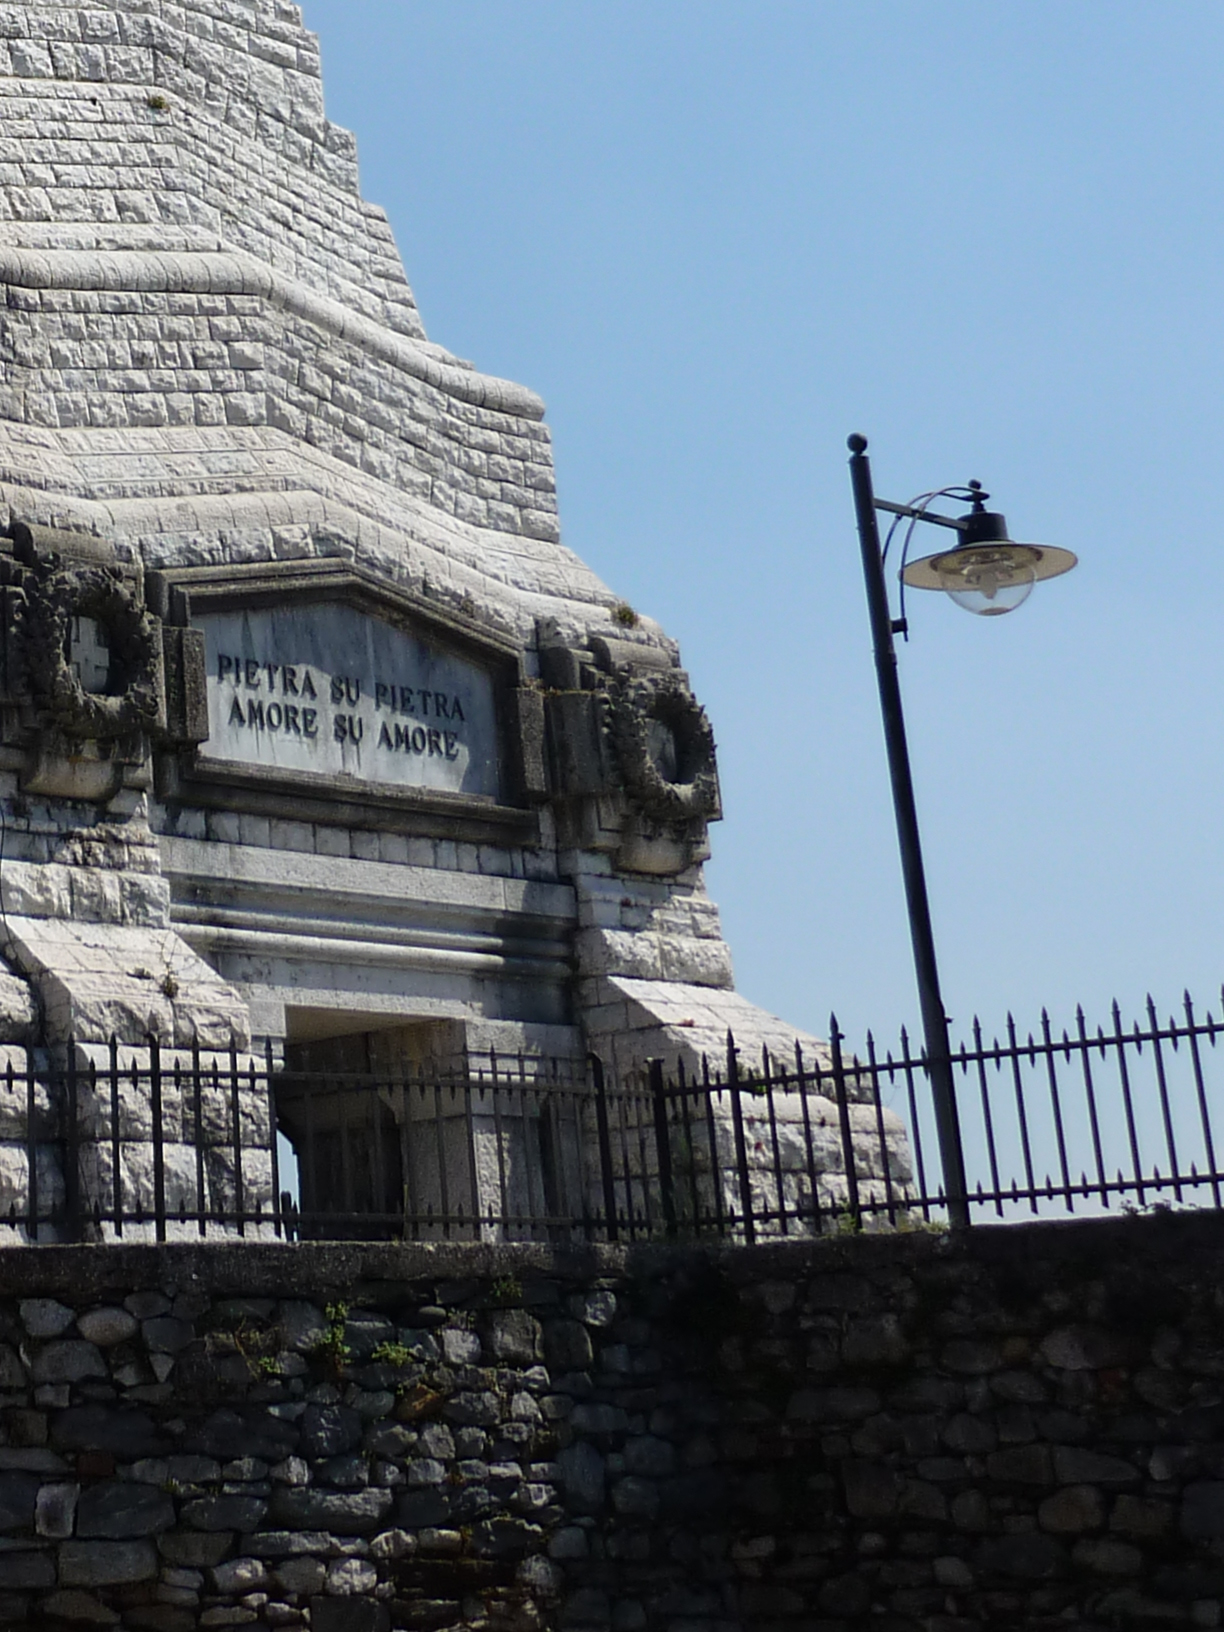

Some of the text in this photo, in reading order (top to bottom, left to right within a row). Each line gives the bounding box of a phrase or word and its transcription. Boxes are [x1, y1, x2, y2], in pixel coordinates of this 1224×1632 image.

[217, 653, 465, 721] PIETRA SU PIETRA
[228, 695, 459, 760] AMORE SU AMORE
